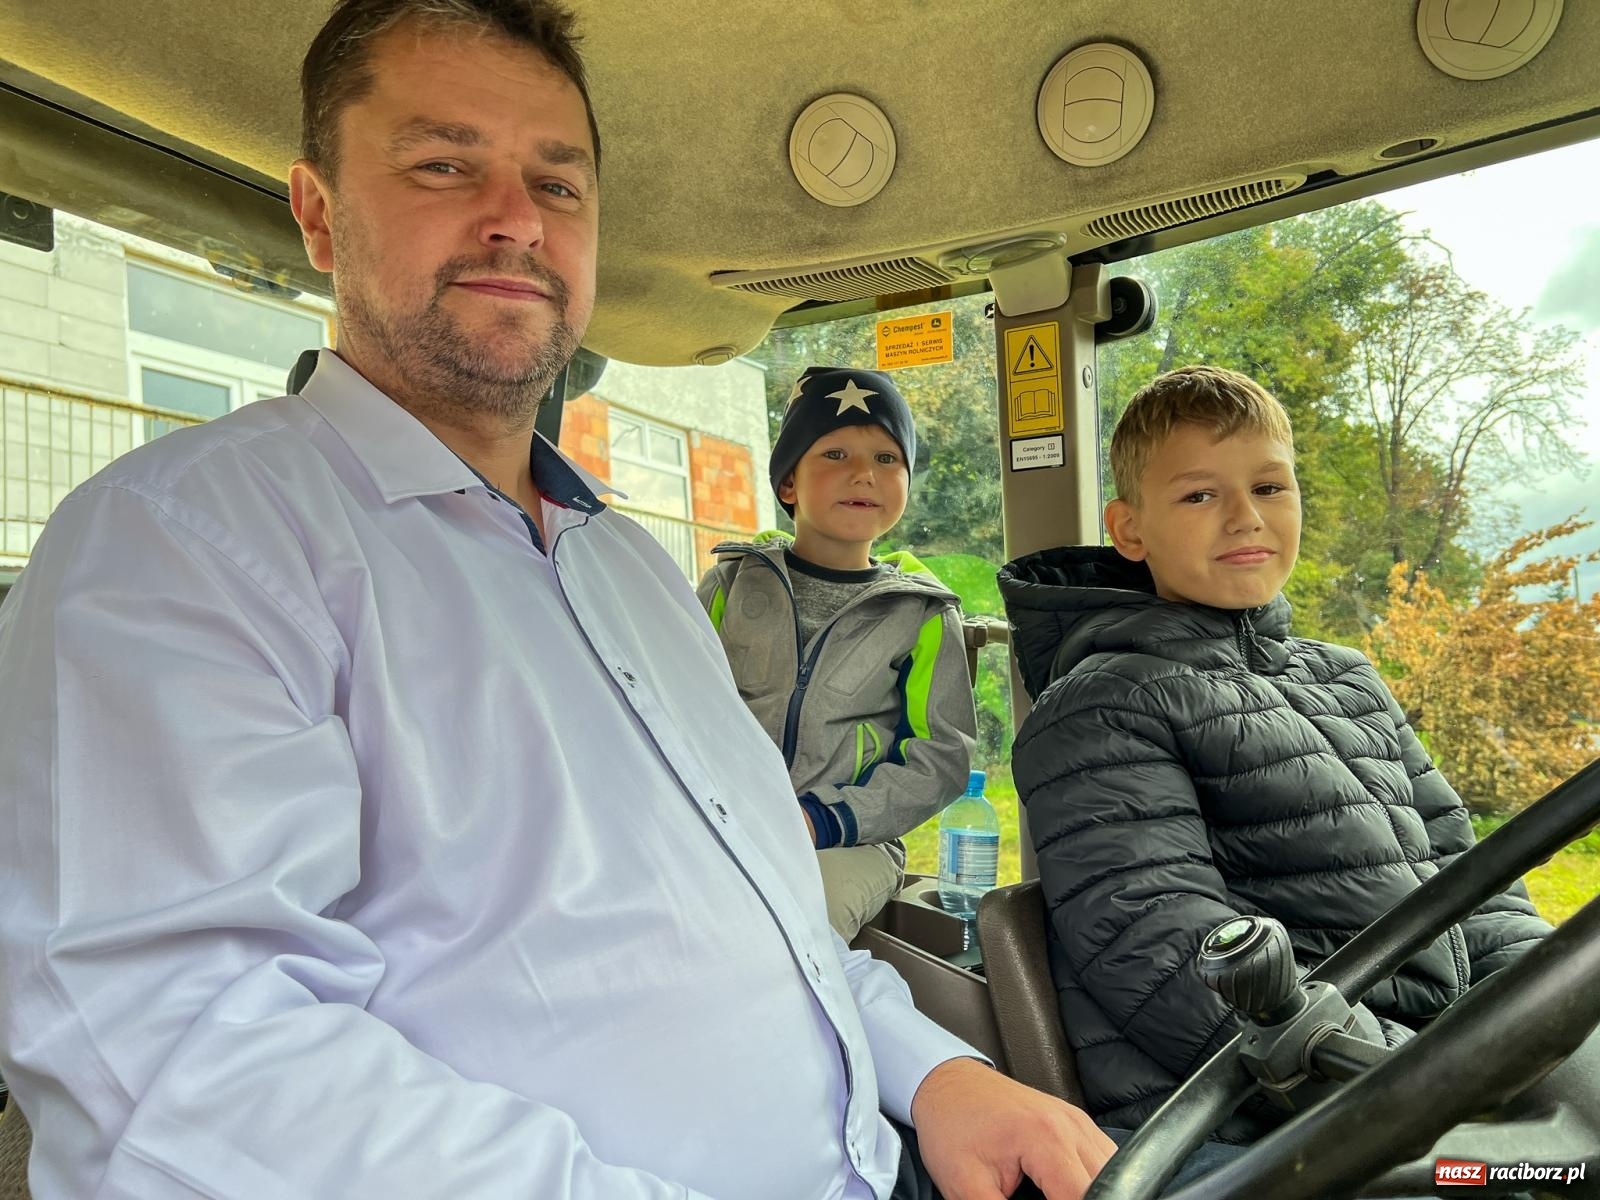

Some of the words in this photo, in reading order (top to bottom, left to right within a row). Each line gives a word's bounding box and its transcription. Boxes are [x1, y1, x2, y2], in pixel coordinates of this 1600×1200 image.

[893, 322, 923, 333] Chempest
[922, 338, 943, 346] SERWIS
[885, 350, 907, 358] MASZYN
[908, 345, 944, 355] ROLNICZYCH
